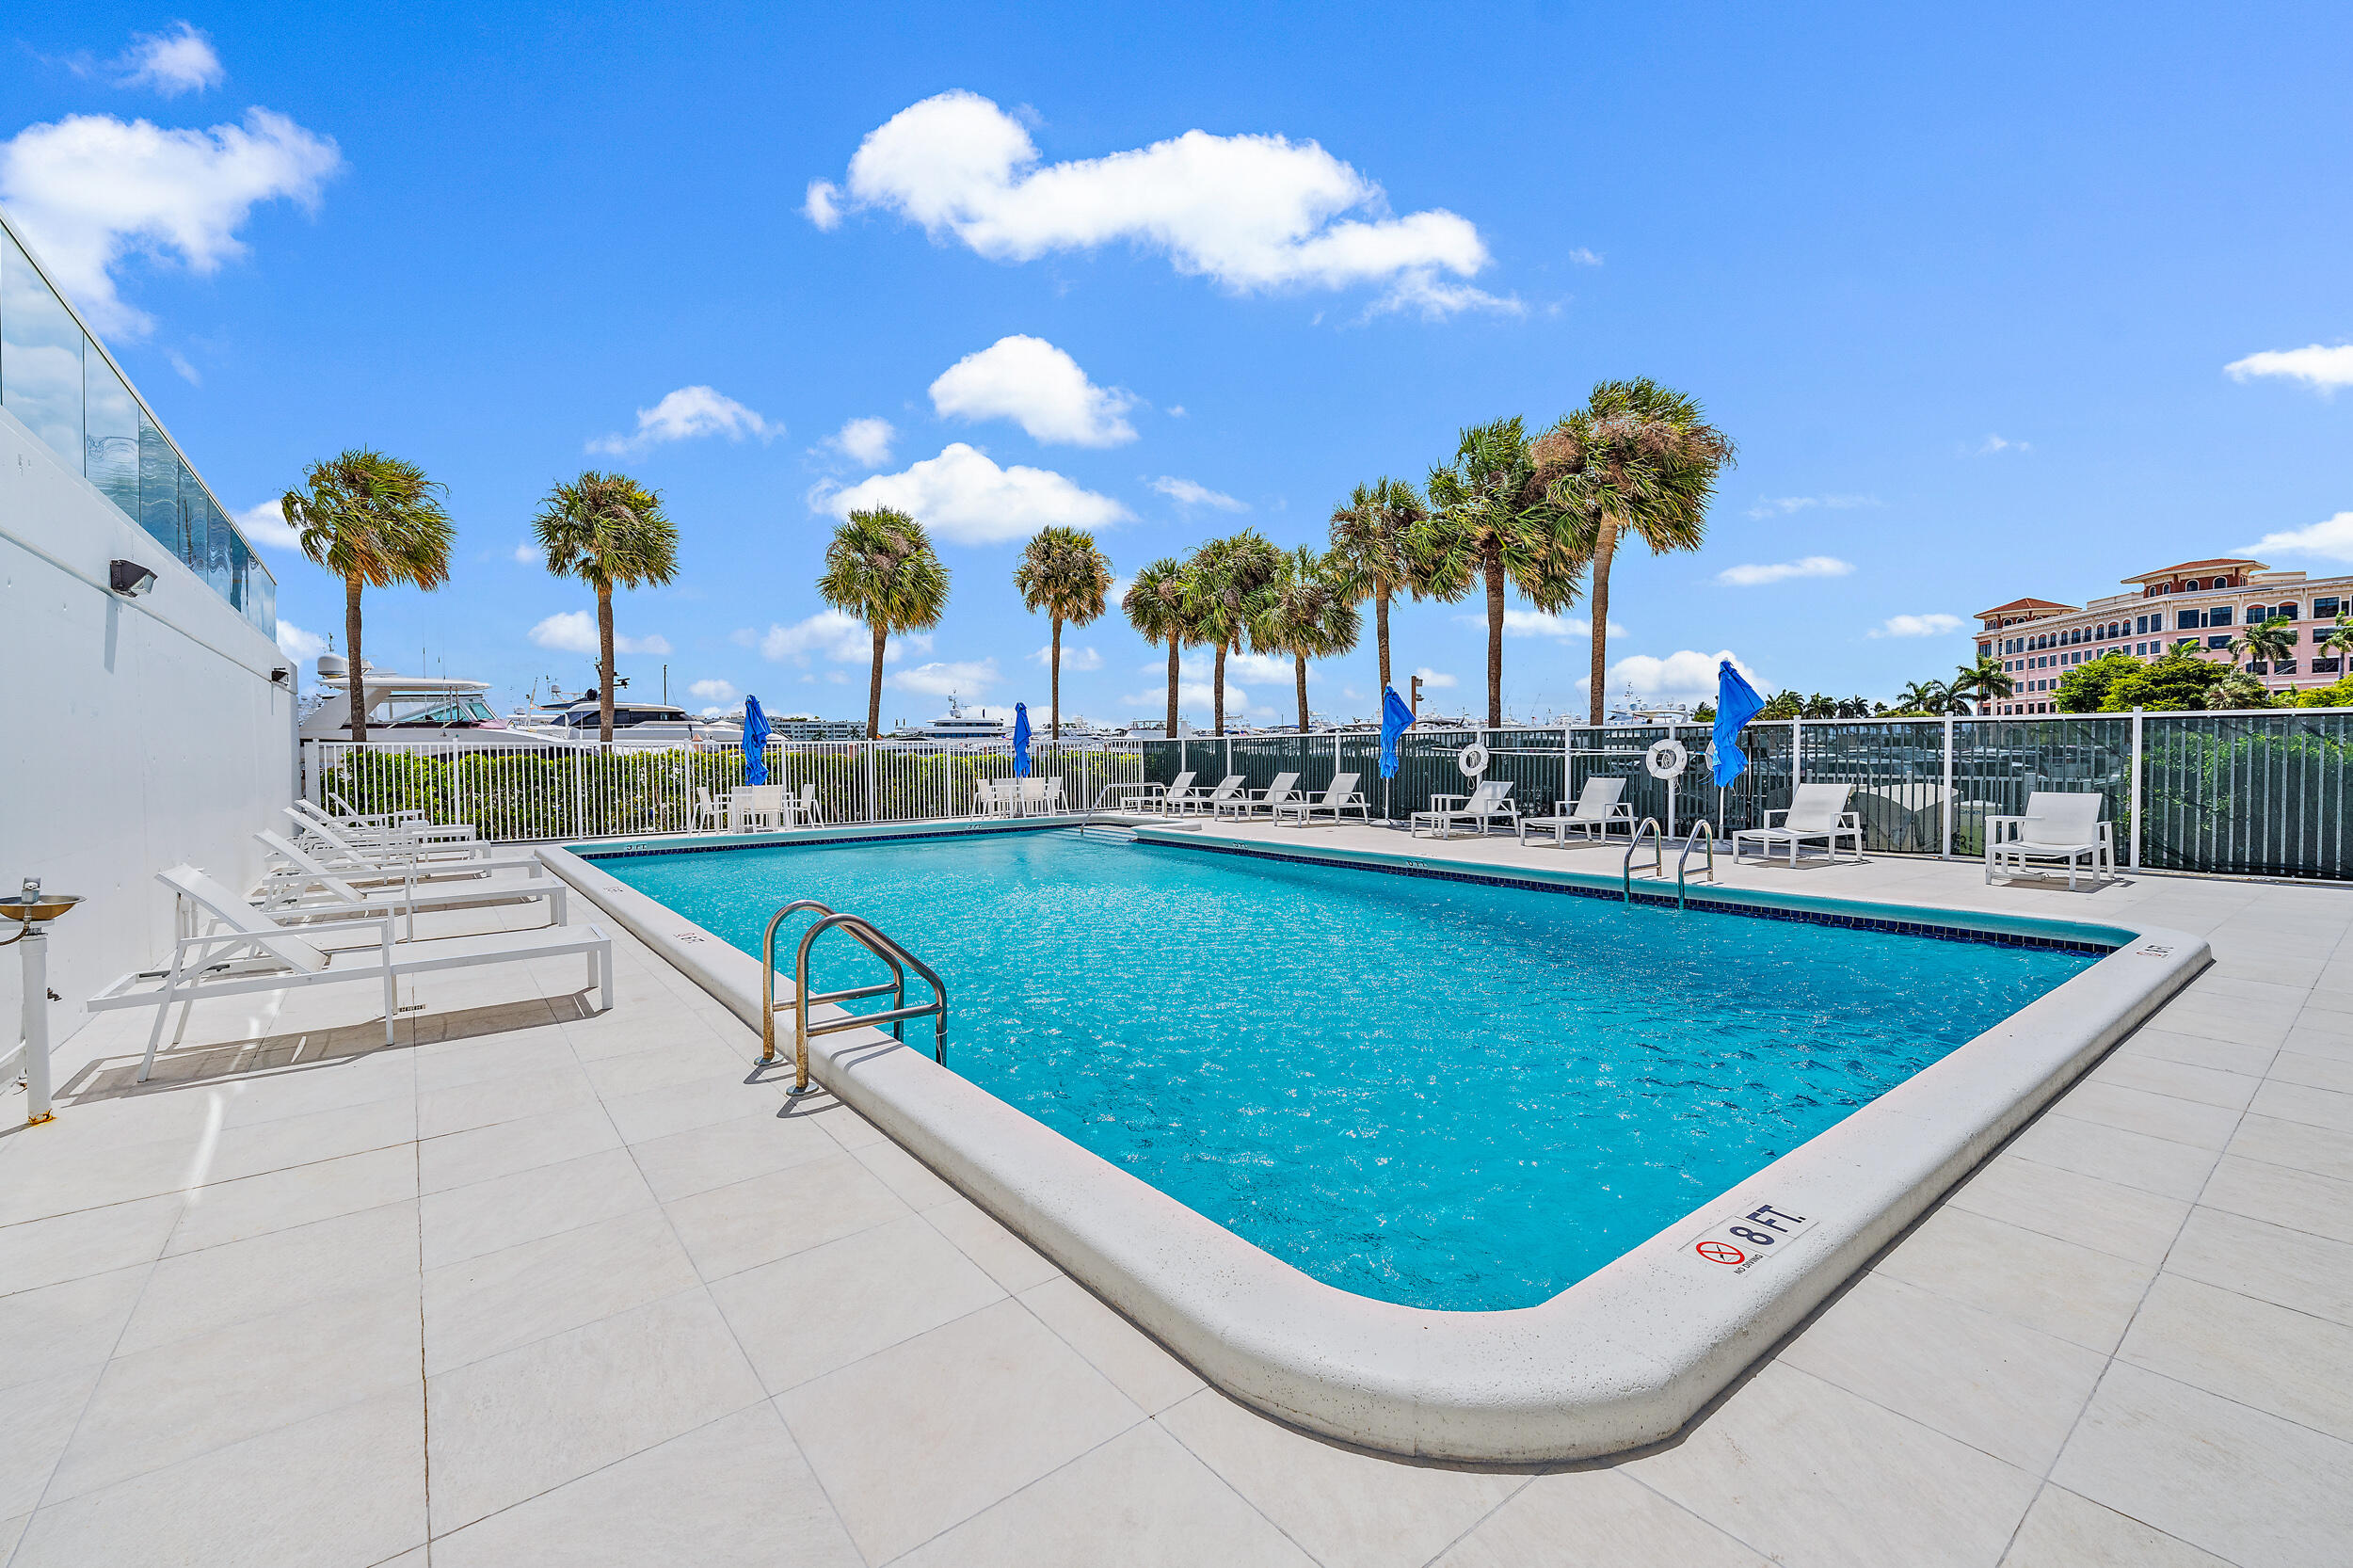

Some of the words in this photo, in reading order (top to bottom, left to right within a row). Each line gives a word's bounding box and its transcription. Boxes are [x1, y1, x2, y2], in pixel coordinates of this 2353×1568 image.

[1745, 1205, 1806, 1233] FT.
[1729, 1226, 1775, 1245] 8
[1734, 1265, 1746, 1275] NO
[1743, 1254, 1764, 1269] DIVING
